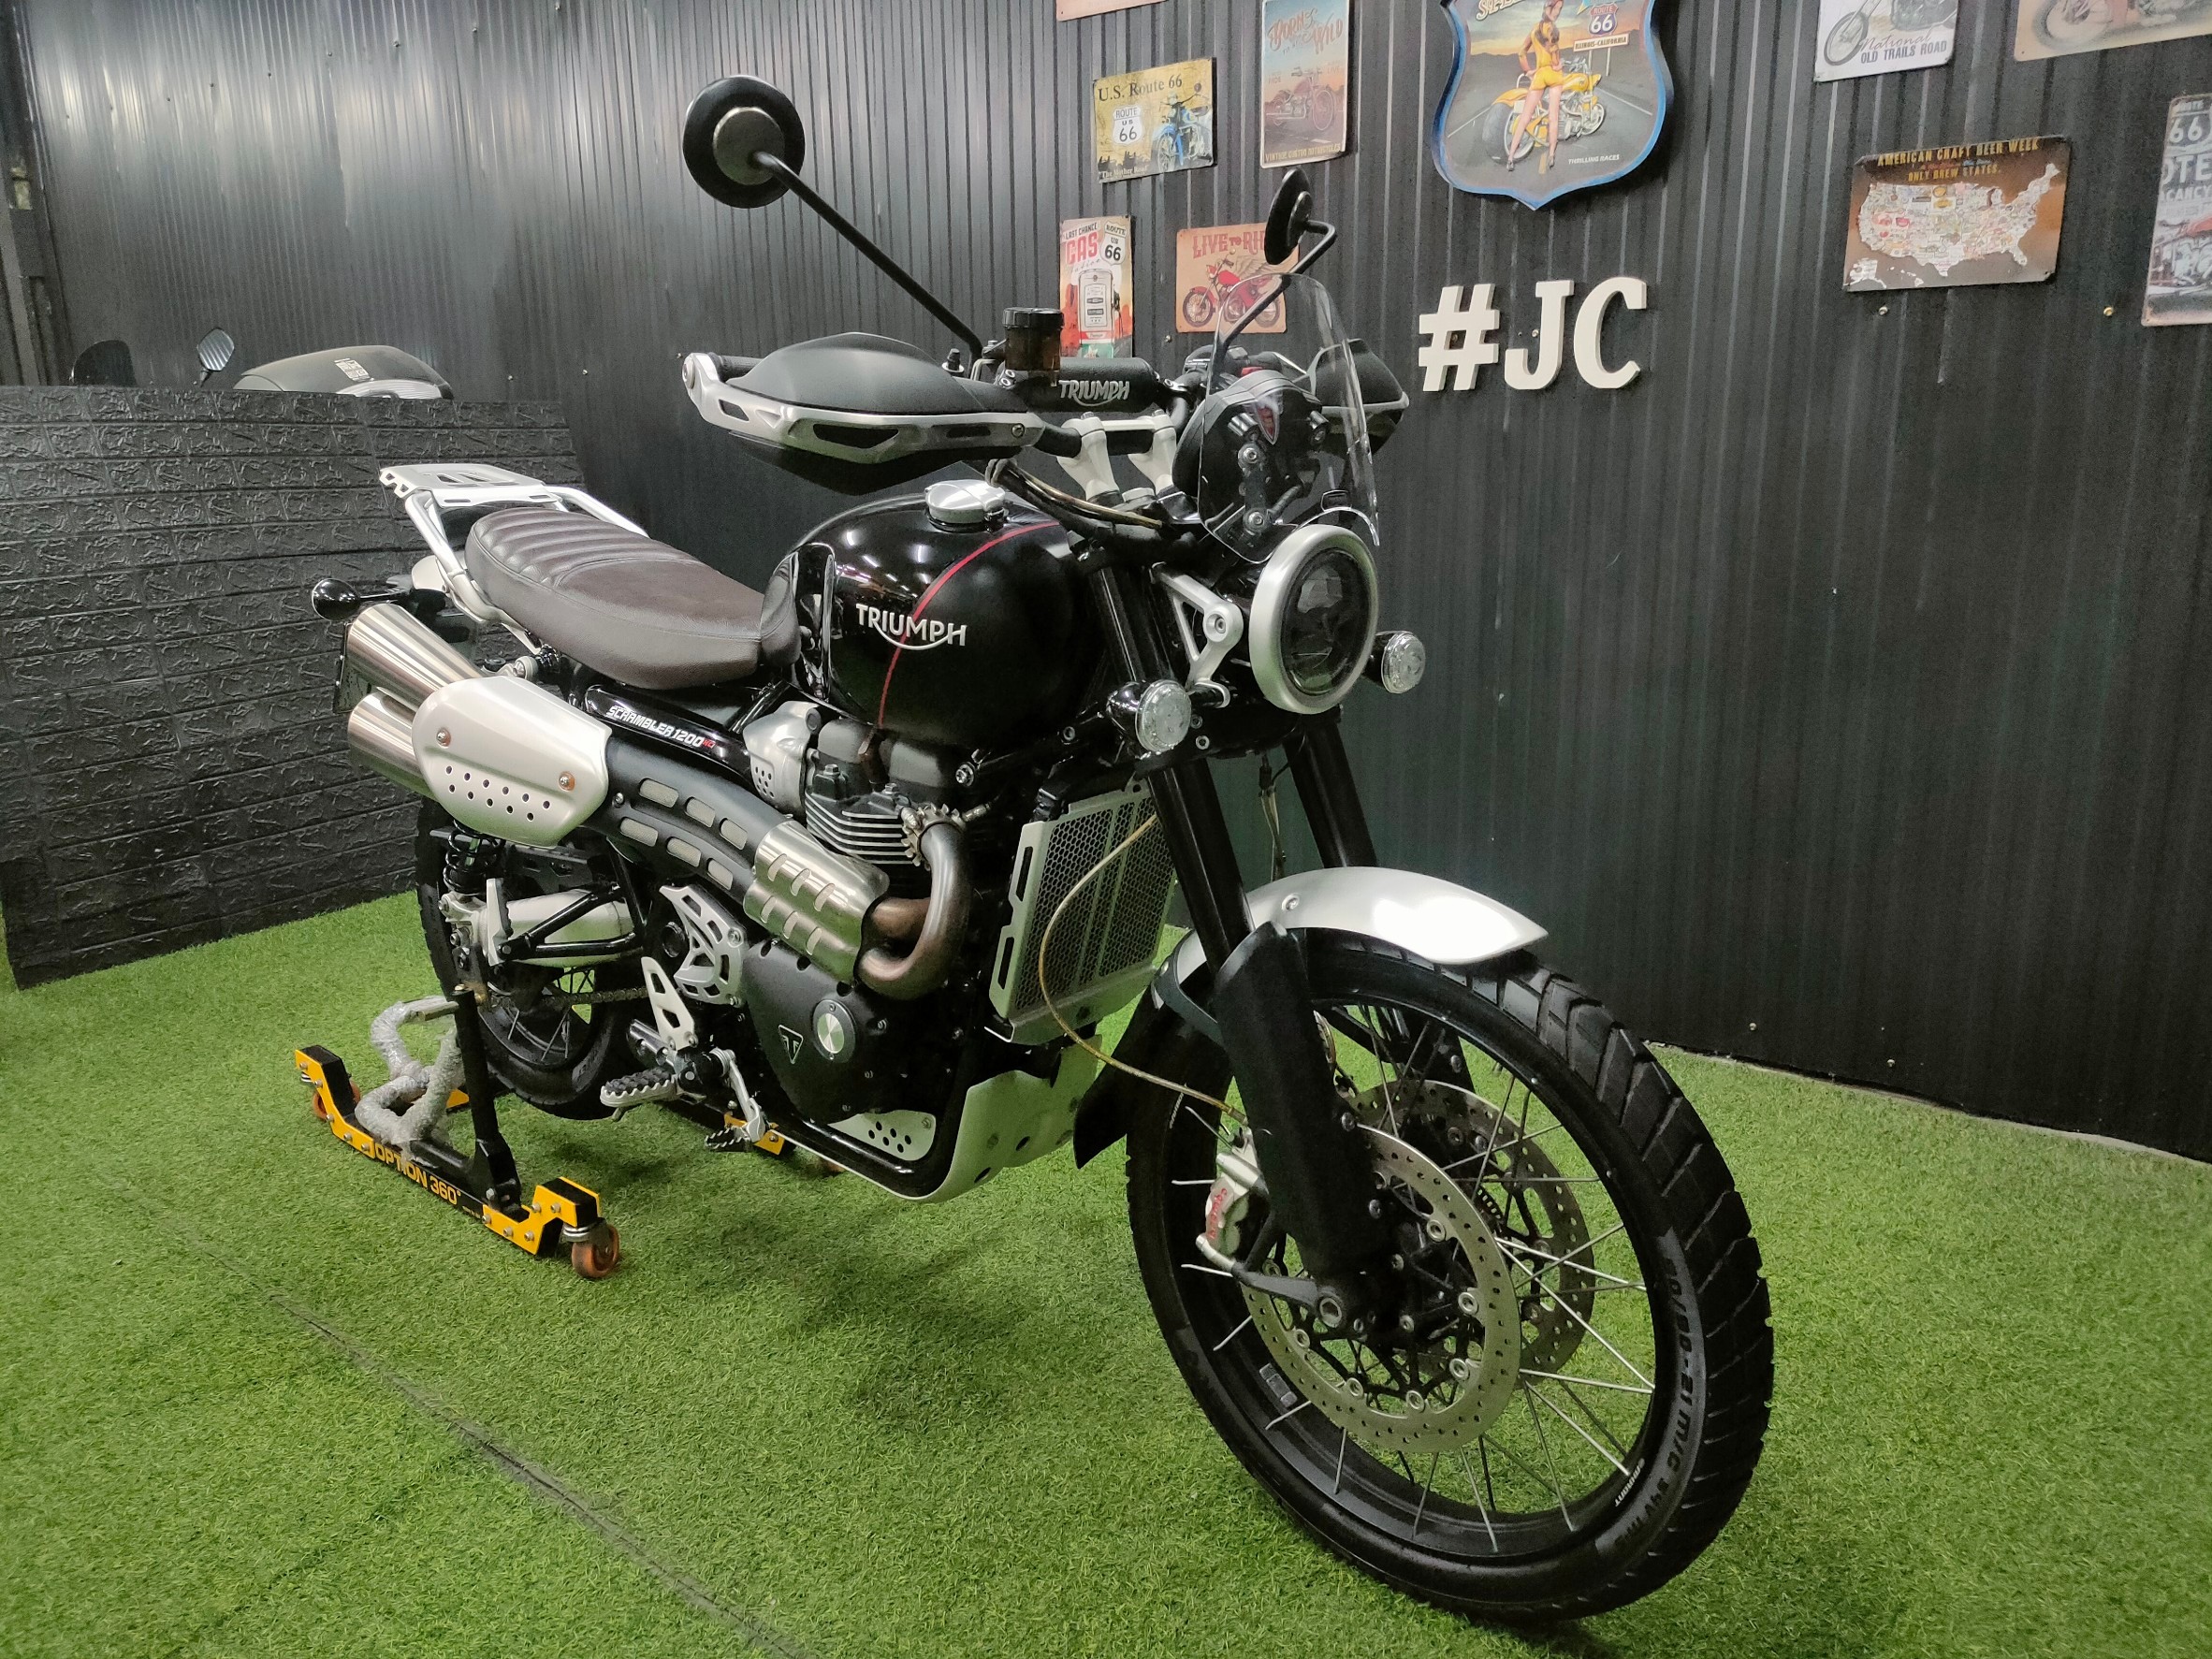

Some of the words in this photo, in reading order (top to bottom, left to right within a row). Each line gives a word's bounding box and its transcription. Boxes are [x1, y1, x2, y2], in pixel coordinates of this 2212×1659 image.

[1594, 5, 1613, 14] ROUTE
[1311, 13, 1344, 54] WILD
[1591, 13, 1613, 34] 66
[1860, 26, 1933, 51] National
[1860, 51, 1879, 65] OLD
[1884, 45, 1916, 61] TRAILS
[1920, 40, 1948, 56] ROAD
[1098, 84, 1125, 102] U.S.
[1129, 79, 1165, 96] Route
[1168, 74, 1183, 89] 66
[1115, 108, 1138, 119] ROUTE
[1119, 125, 1138, 142] 66
[2169, 114, 2203, 143] 66
[1264, 150, 1288, 162] VINTAGE
[1568, 155, 1599, 165] THRILLING
[1599, 153, 1620, 162] RACES
[1877, 150, 1932, 167] AMERICAN
[1936, 146, 1971, 161] CRAFT
[1975, 141, 2003, 156] BEER
[2008, 138, 2040, 153] WEEK
[1908, 170, 1930, 182] ONLY
[1932, 167, 1958, 180] BREW
[1065, 229, 1078, 240] LAST
[1078, 222, 1098, 236] CHANCE
[1106, 224, 1126, 236] ROUTE
[1111, 237, 1119, 245] US
[1066, 231, 1098, 265] GAS
[1105, 244, 1122, 261] 66
[1192, 233, 1229, 259] LIVE
[1228, 236, 1242, 246] TO
[1058, 379, 1130, 406] TRIUMPH
[855, 603, 968, 650] TRIUMPH
[605, 705, 676, 738] SCRAMBLER
[672, 728, 705, 748] 1200
[1207, 1187, 1228, 1240] brembo
